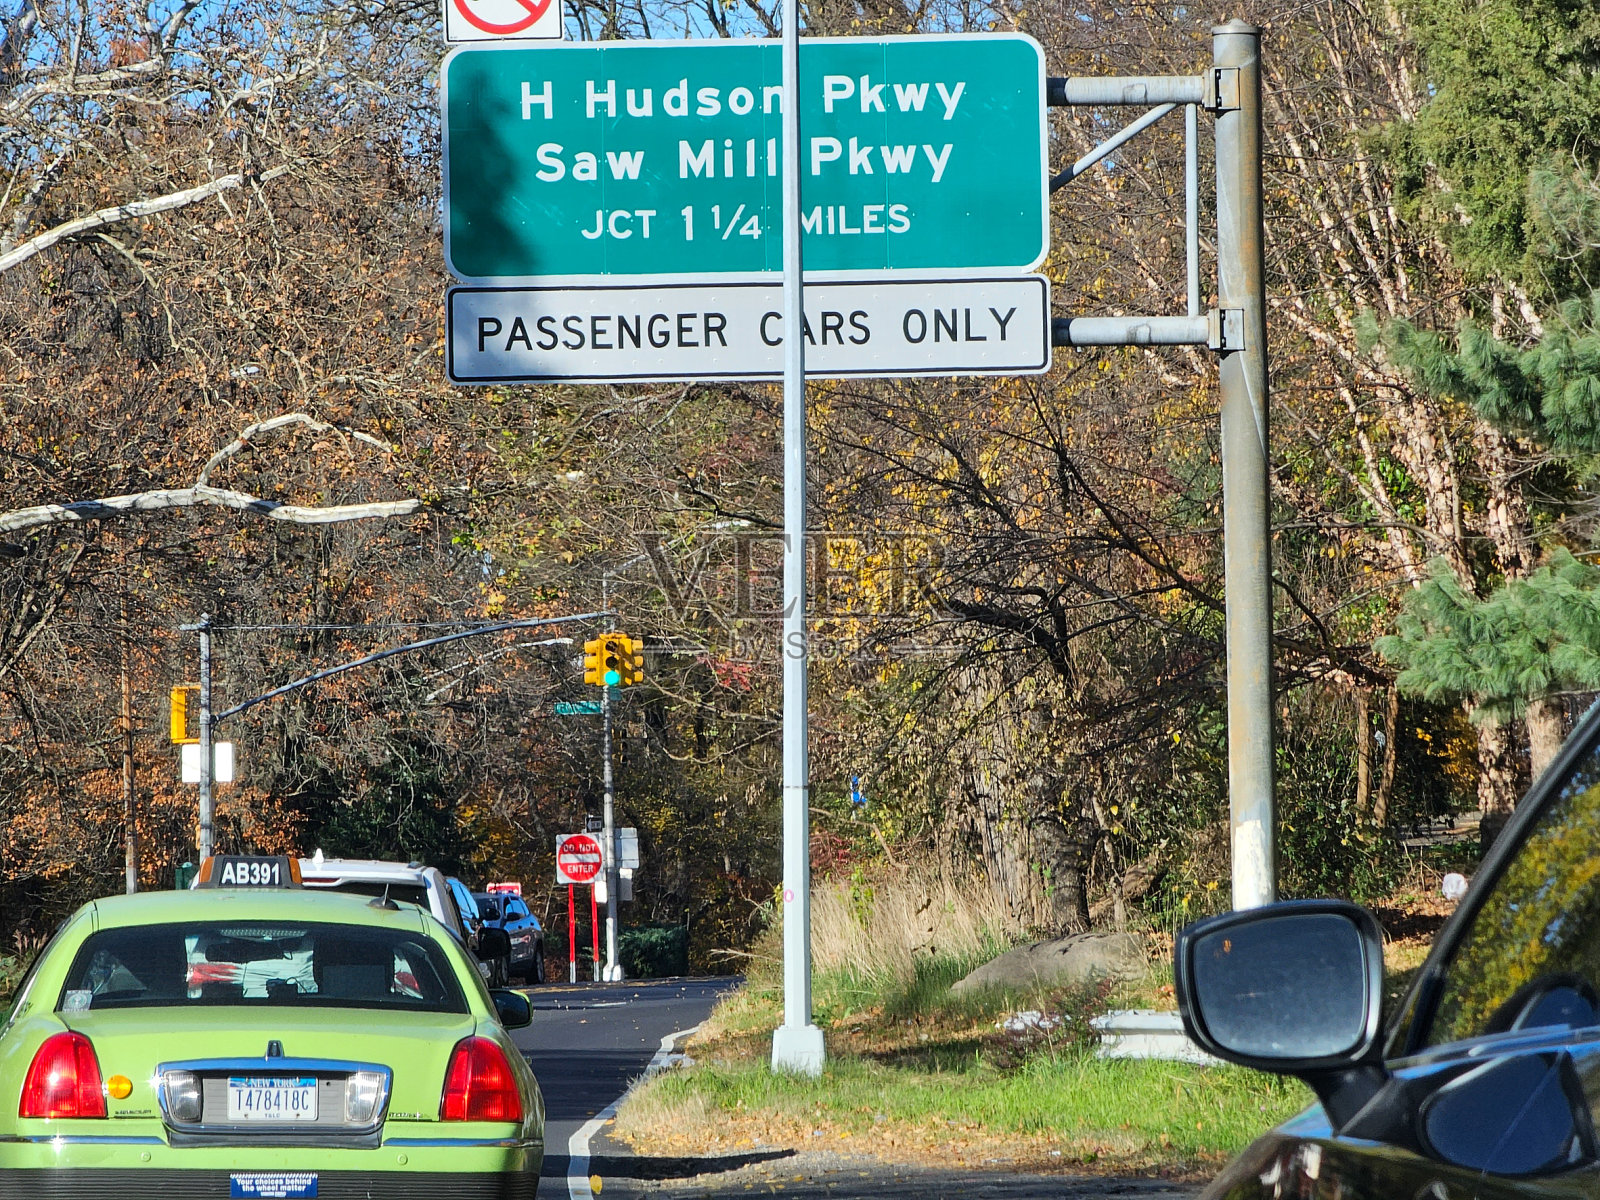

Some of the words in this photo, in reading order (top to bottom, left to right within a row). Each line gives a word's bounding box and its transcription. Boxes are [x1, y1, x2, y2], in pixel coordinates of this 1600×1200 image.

[520, 81, 553, 120] H
[585, 78, 783, 119] Hudson
[823, 73, 966, 119] Pkwy
[536, 144, 645, 183] Saw
[679, 139, 778, 179] Mill
[811, 137, 953, 183] Pkwy
[581, 209, 656, 240] JCT
[681, 206, 693, 240] 1
[801, 204, 911, 235] MILES
[478, 312, 728, 352] PASSENGER
[903, 308, 1016, 344] ONLY
[563, 844, 575, 852] DO
[579, 844, 596, 852] NOT
[221, 862, 279, 885] AB391
[567, 864, 594, 873] ENTER
[250, 1078, 271, 1088] NEW
[273, 1078, 295, 1088] YORK
[236, 1089, 309, 1111] T478418C
[285, 1177, 312, 1185] behind
